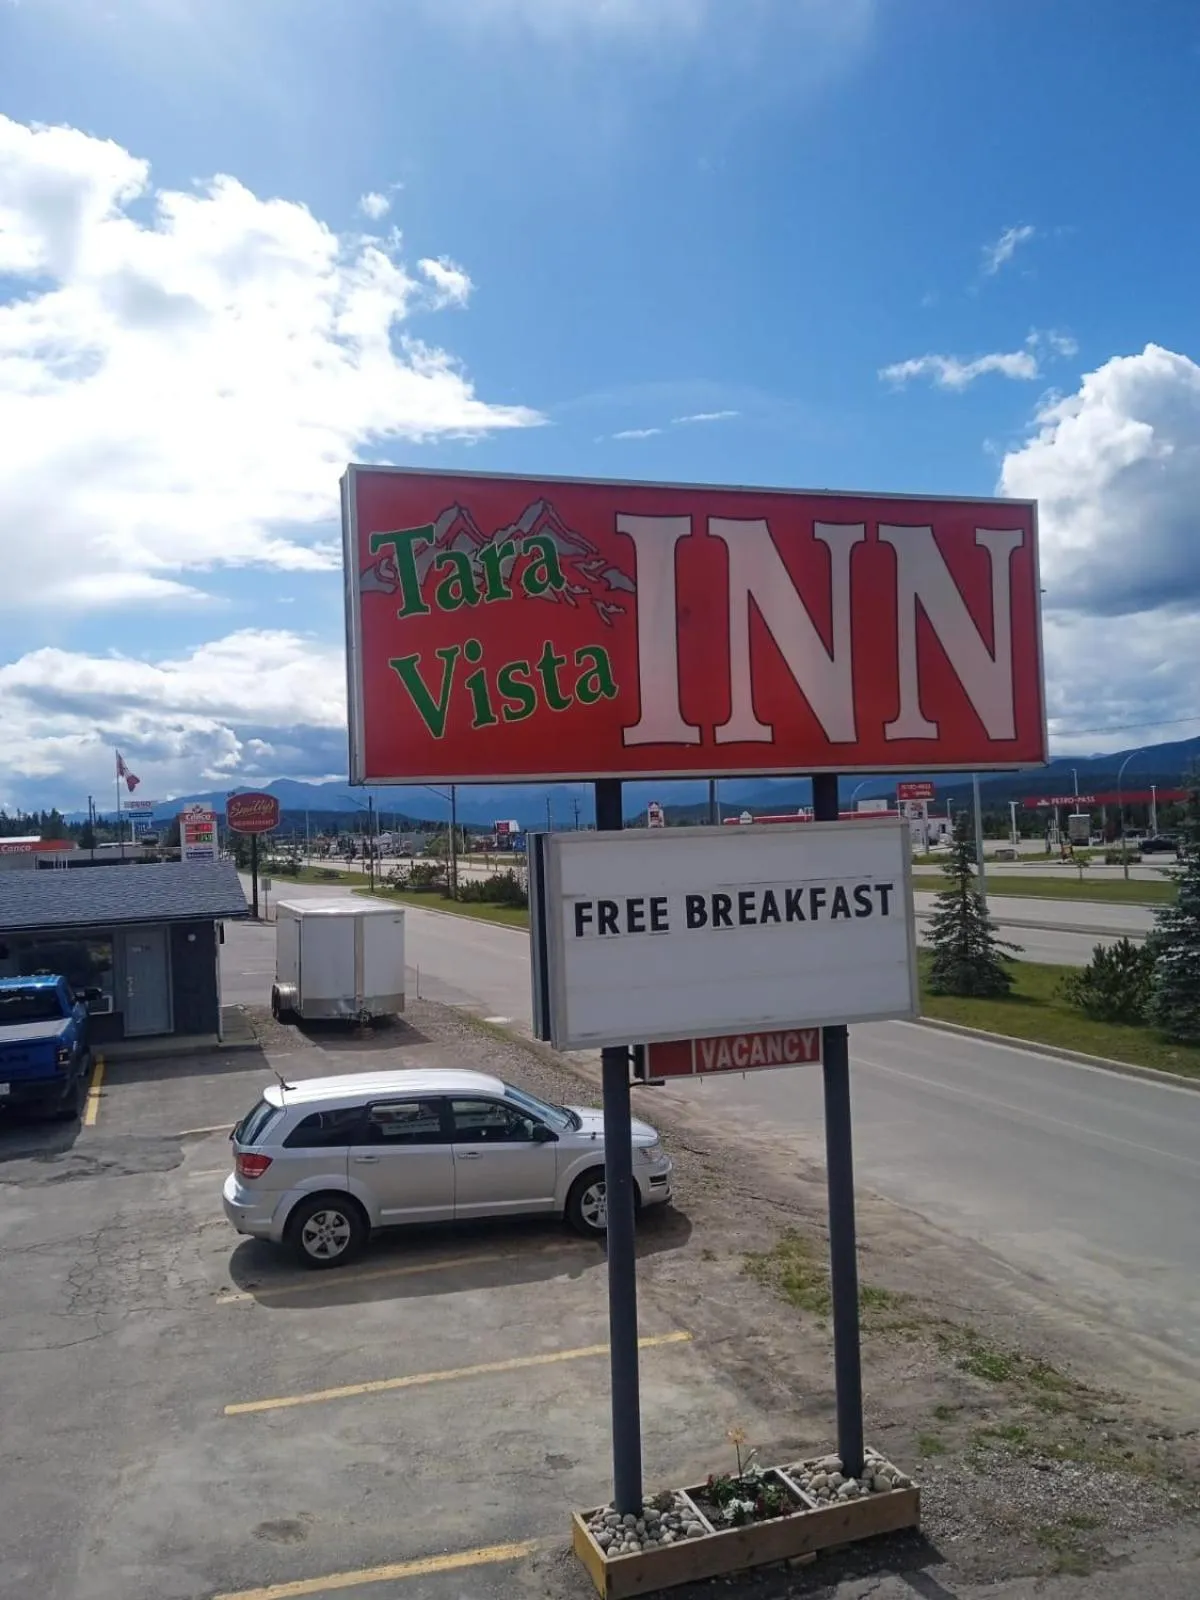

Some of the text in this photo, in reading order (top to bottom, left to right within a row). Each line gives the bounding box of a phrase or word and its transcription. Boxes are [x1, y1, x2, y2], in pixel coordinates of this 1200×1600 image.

[369, 523, 566, 618] Tara
[615, 512, 1025, 744] INN
[389, 638, 619, 739] Vista
[0, 844, 32, 854] Canco
[574, 883, 894, 937] FREE BREAKFAST
[701, 1030, 818, 1070] VACANCY
